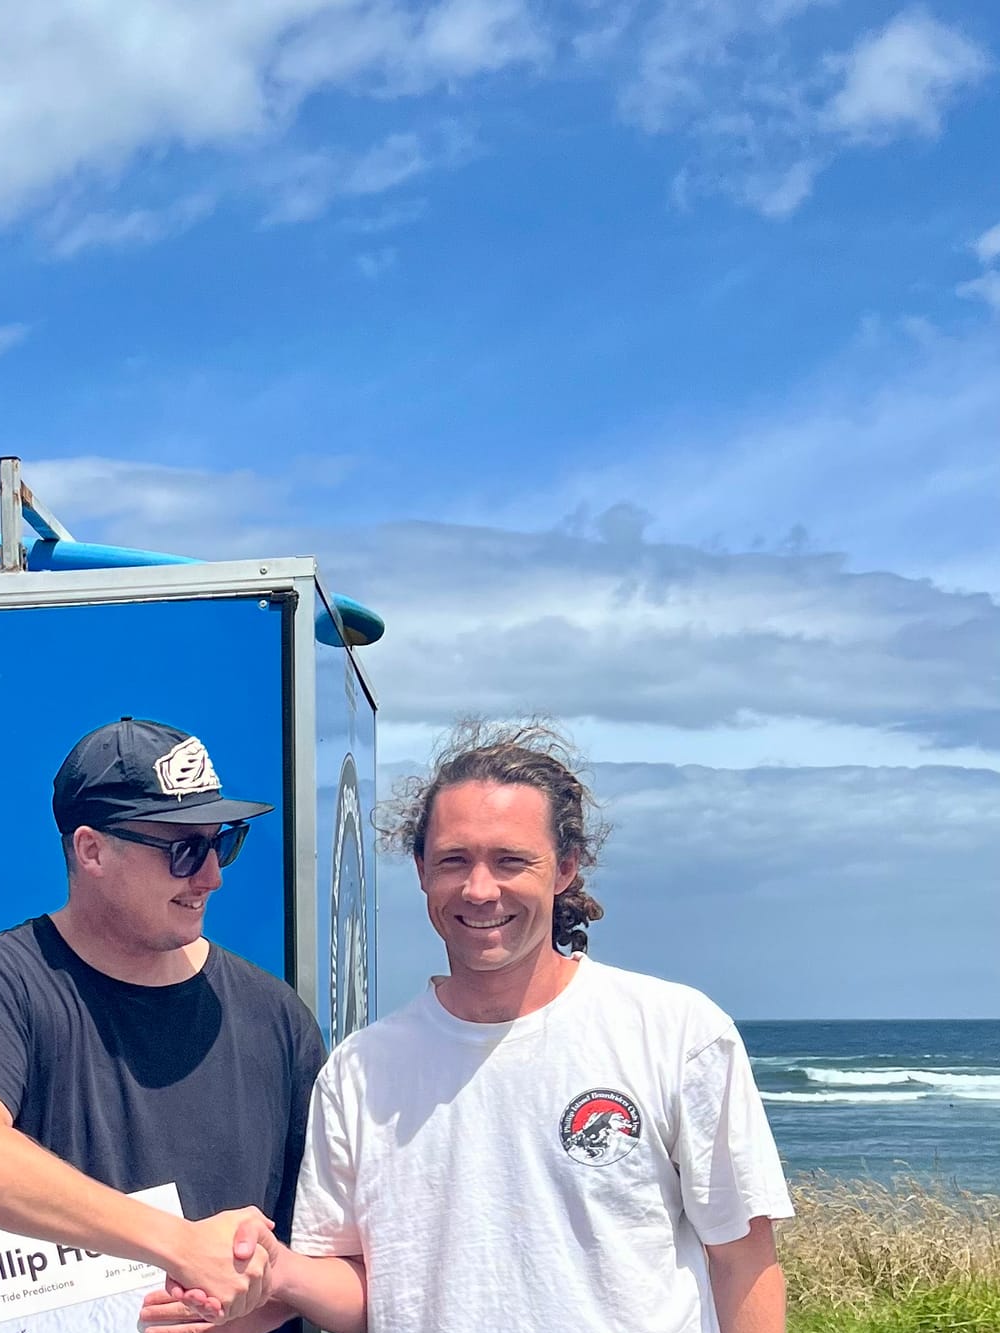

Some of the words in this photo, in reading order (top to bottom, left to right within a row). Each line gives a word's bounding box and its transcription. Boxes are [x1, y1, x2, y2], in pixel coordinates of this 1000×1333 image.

[105, 1268, 120, 1279] Jan
[128, 1264, 144, 1273] Jun
[1, 1290, 21, 1304] Tide
[22, 1279, 74, 1298] Predictions
